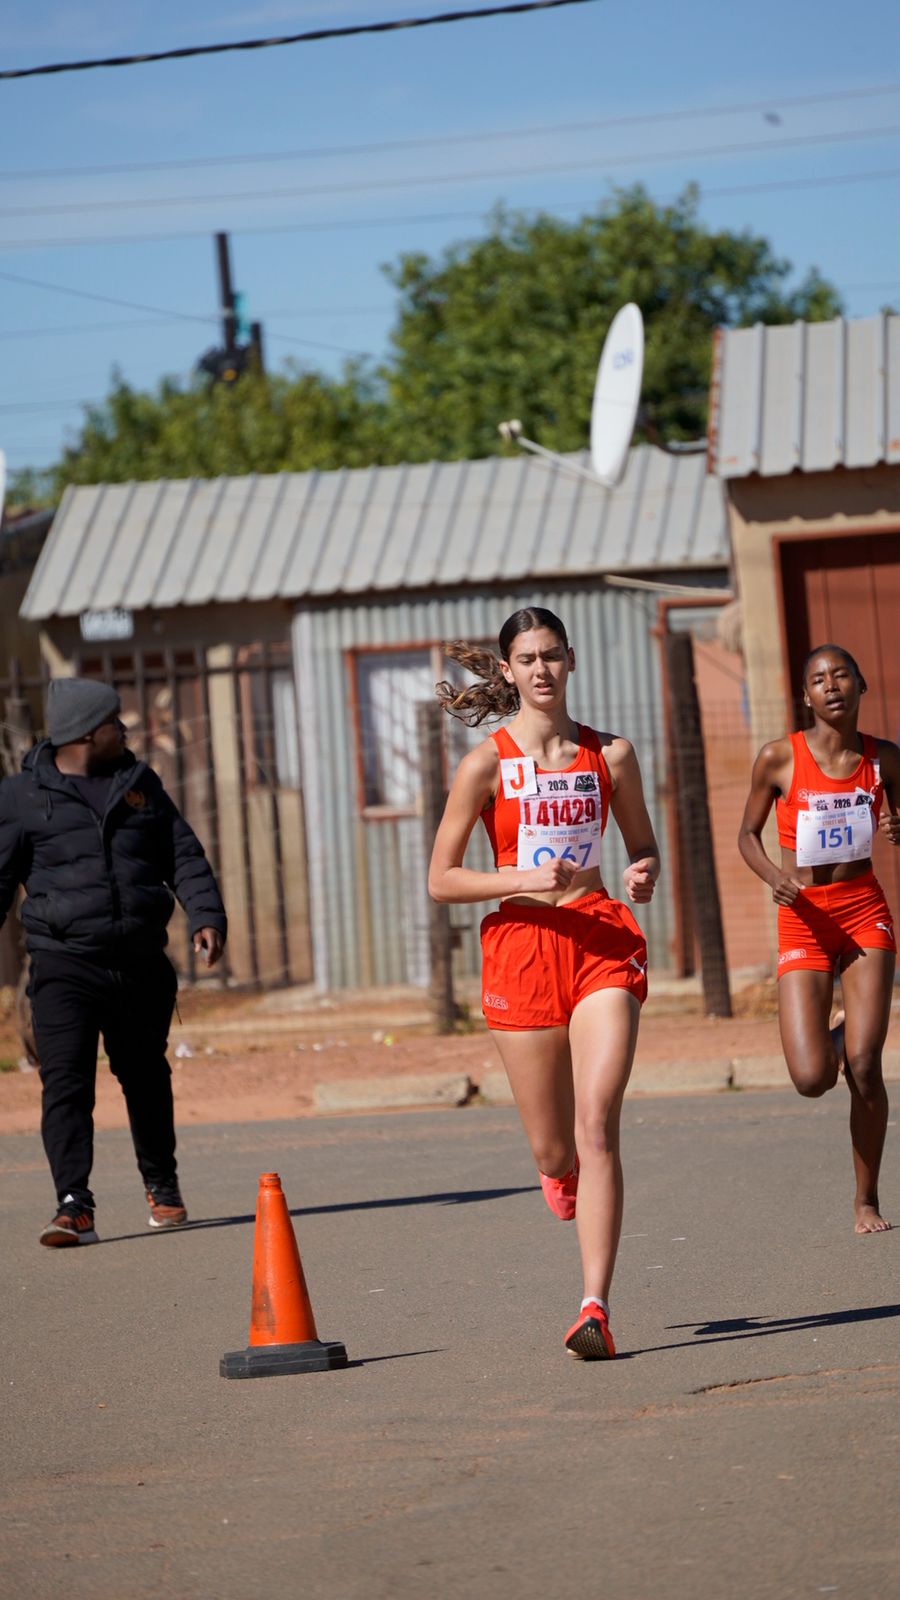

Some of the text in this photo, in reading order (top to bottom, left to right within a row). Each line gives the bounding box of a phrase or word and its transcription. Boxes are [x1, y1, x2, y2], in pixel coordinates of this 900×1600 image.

[510, 763, 525, 790] J
[548, 779, 569, 792] 2026
[833, 798, 851, 809] 2026
[549, 836, 567, 844] STREET
[817, 826, 853, 849] 151
